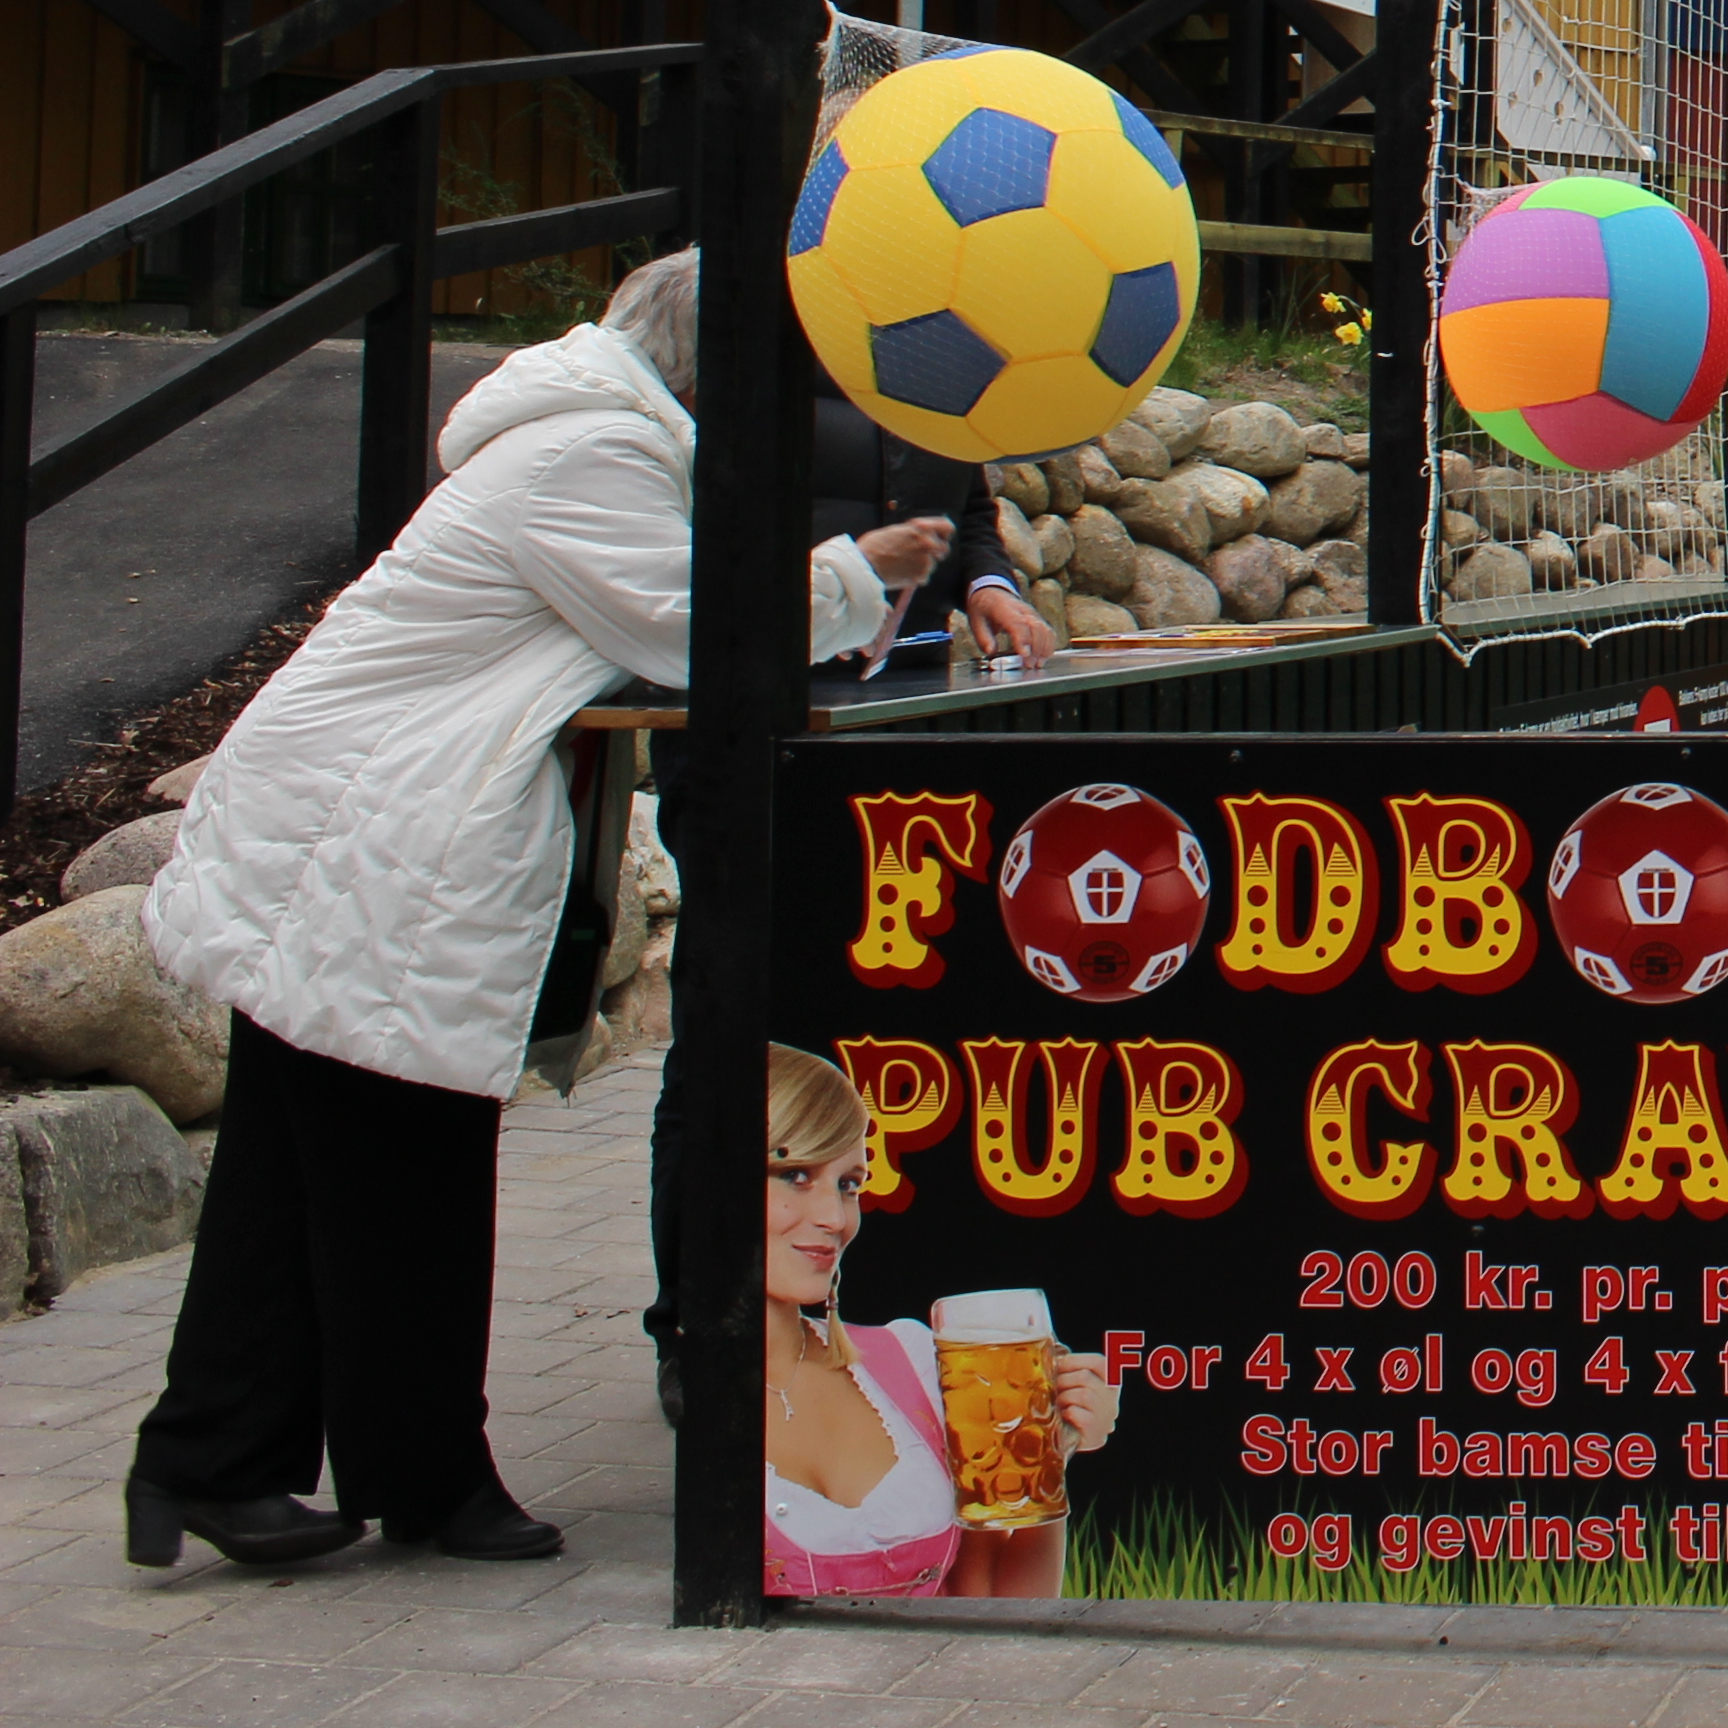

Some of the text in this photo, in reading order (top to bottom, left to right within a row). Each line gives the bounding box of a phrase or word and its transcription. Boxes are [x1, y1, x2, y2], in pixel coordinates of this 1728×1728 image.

[832, 1032, 1250, 1219] PUB
[1299, 1251, 1437, 1313] 200
[1464, 1250, 1553, 1313] kr.
[1581, 1261, 1673, 1324] pr.
[1104, 1330, 1222, 1390] For
[1244, 1332, 1291, 1390] 4
[1313, 1347, 1356, 1391] x
[1378, 1332, 1443, 1392] øl
[1470, 1346, 1557, 1409] og
[1583, 1334, 1630, 1393] 4
[1655, 1349, 1697, 1394] x
[1240, 1414, 1396, 1478] Stor
[1416, 1416, 1658, 1479] bamse
[1267, 1501, 1361, 1563] og
[1377, 1502, 1646, 1566] gevinst
